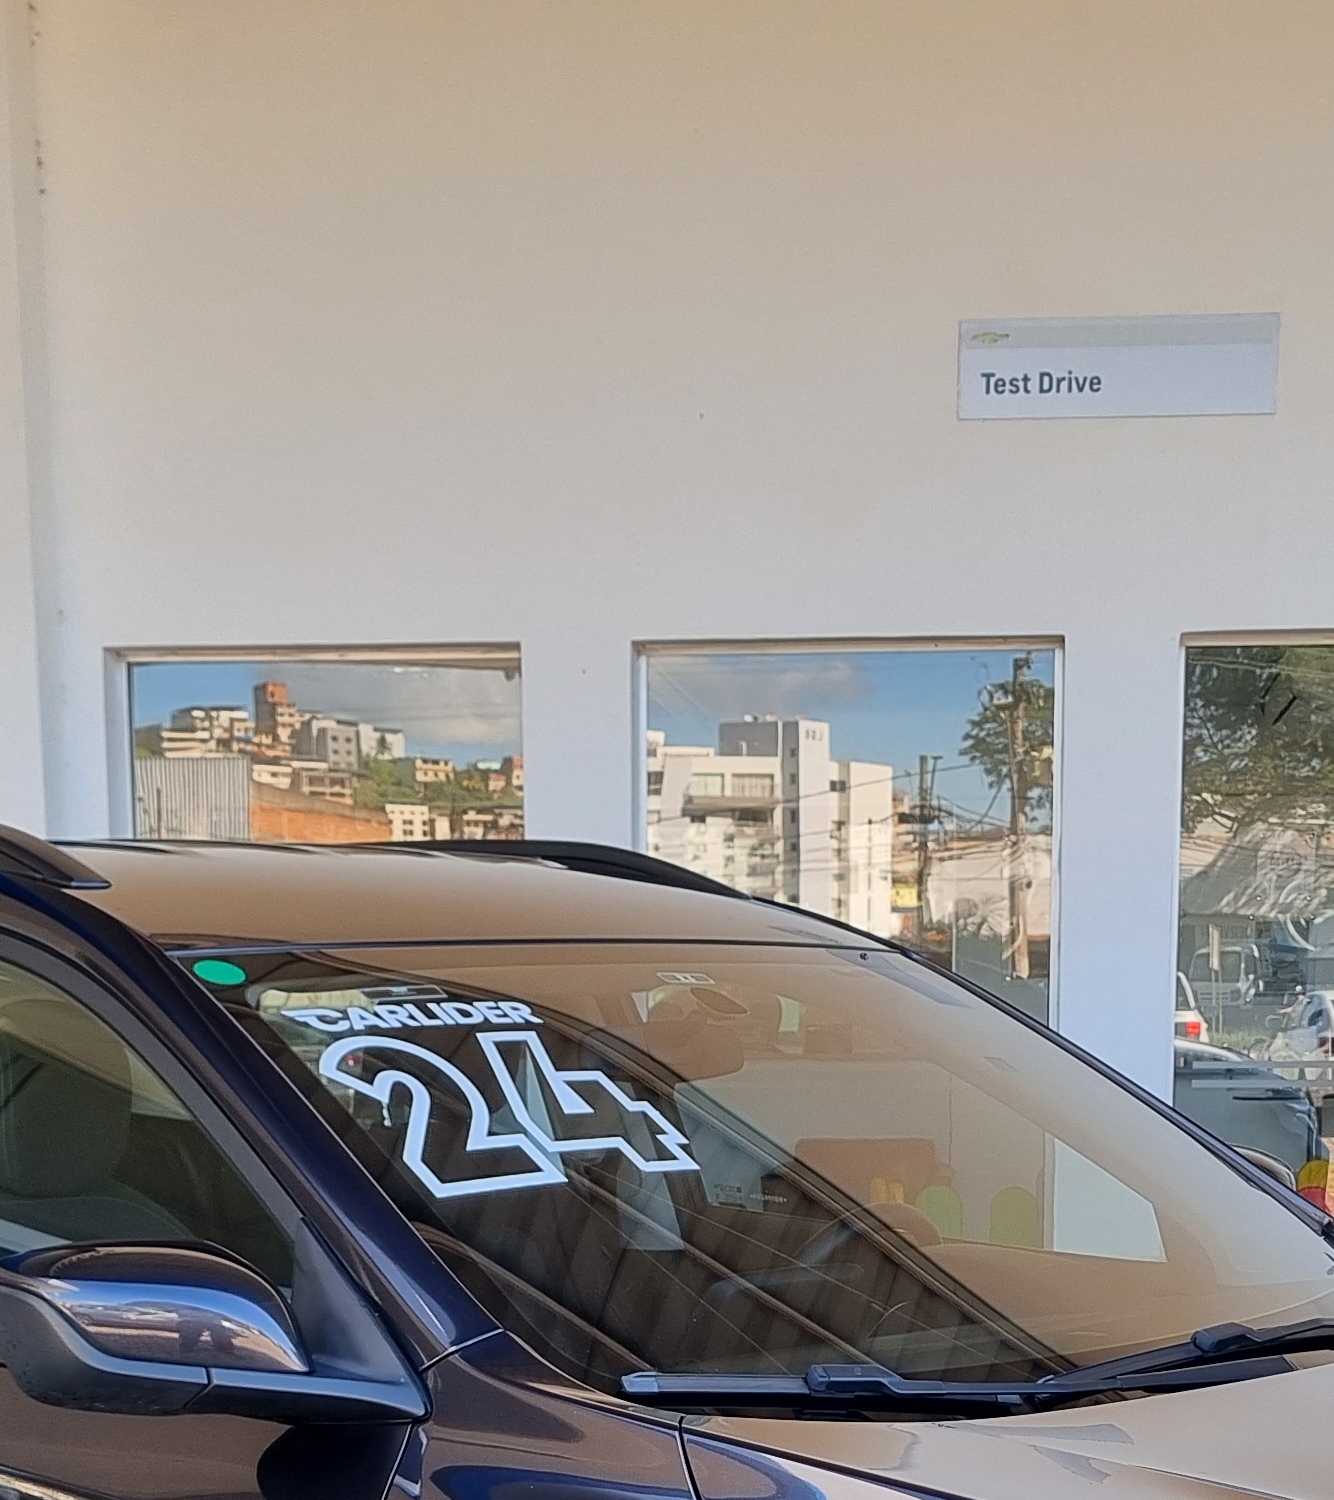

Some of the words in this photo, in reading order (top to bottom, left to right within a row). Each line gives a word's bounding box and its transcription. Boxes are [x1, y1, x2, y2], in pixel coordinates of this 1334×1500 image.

[980, 371, 1031, 395] Test
[1038, 370, 1102, 394] Drive
[281, 1001, 544, 1031] CARLIDER
[318, 1031, 701, 1199] 24
